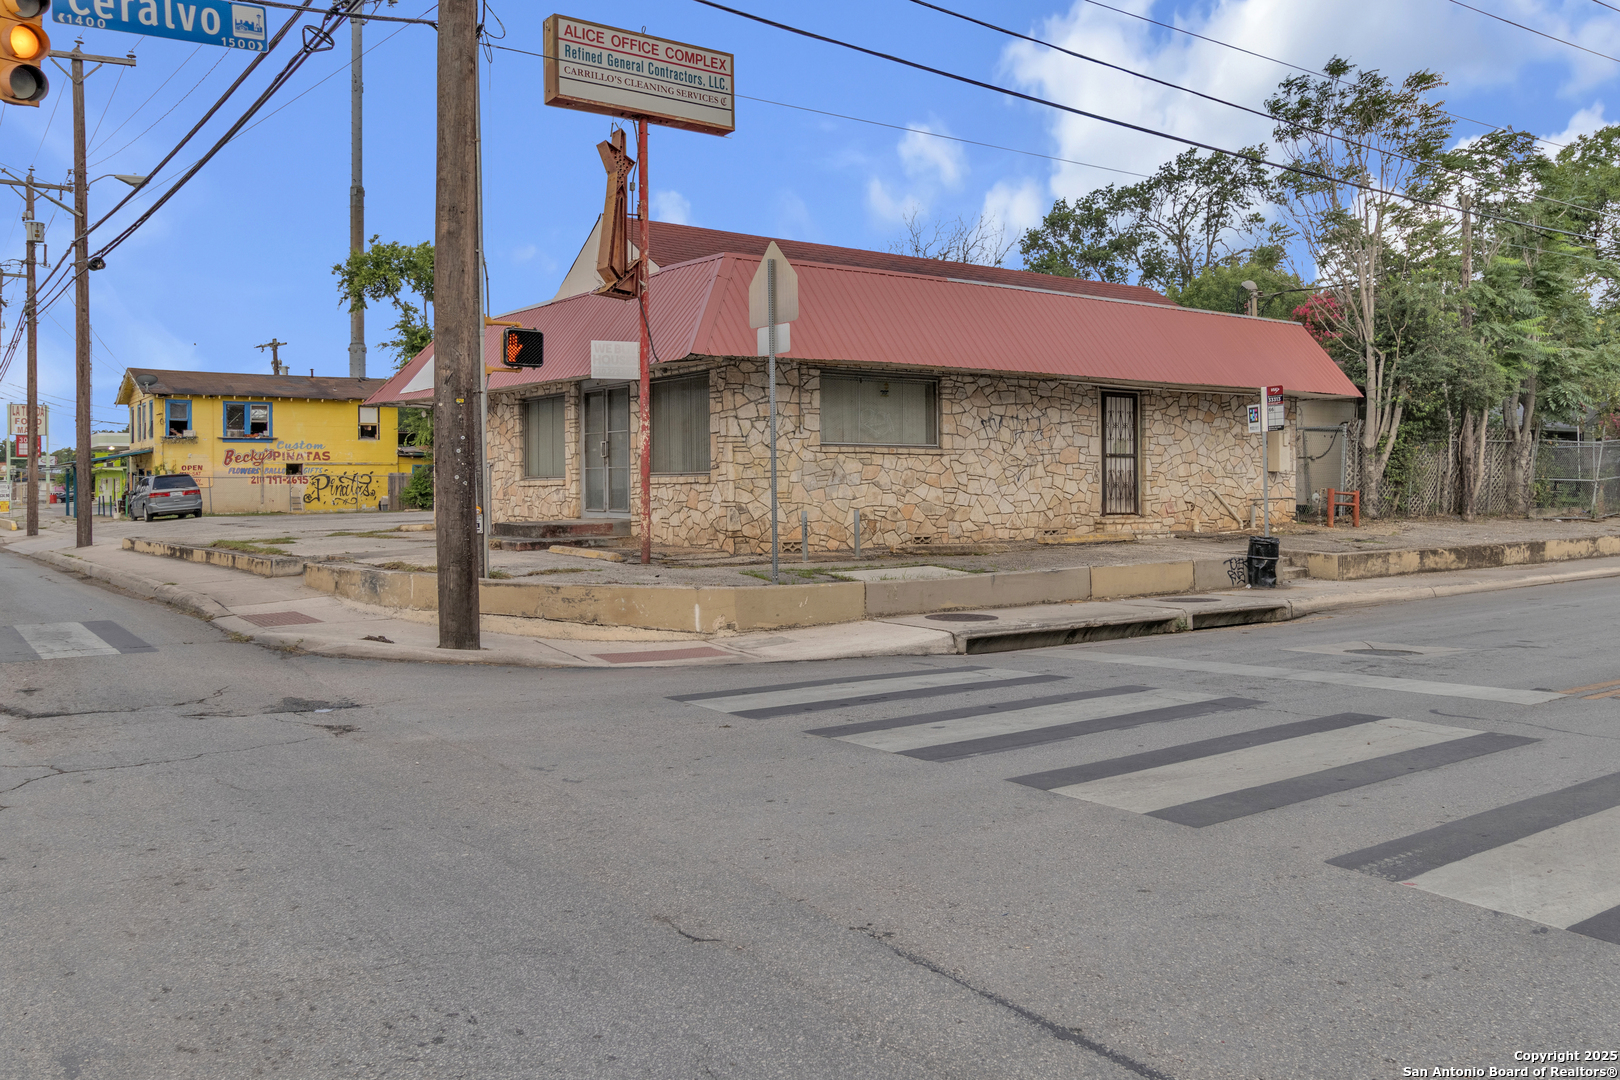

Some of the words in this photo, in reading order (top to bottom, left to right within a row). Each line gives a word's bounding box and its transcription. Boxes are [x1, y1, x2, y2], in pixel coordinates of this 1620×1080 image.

[68, 14, 106, 28] 1400
[221, 37, 256, 51] 1500
[563, 24, 605, 44] ALICE
[611, 34, 660, 56] OFFICE
[665, 47, 727, 71] COMPLEX
[564, 44, 603, 65] Refined
[607, 53, 644, 73] General
[648, 62, 706, 87] Contractors,
[708, 75, 728, 91] LLC.
[563, 66, 622, 85] CARRILLO'S
[624, 78, 675, 95] CLEANING
[676, 88, 719, 104] SERVICES
[594, 343, 613, 353] WE
[12, 405, 21, 416] LA
[15, 417, 42, 425] FOD
[276, 440, 326, 450] Custom
[224, 449, 274, 467] Becky's
[181, 464, 203, 472] OPEN
[228, 467, 261, 475] FLOWERS
[303, 467, 323, 475] GIFTS
